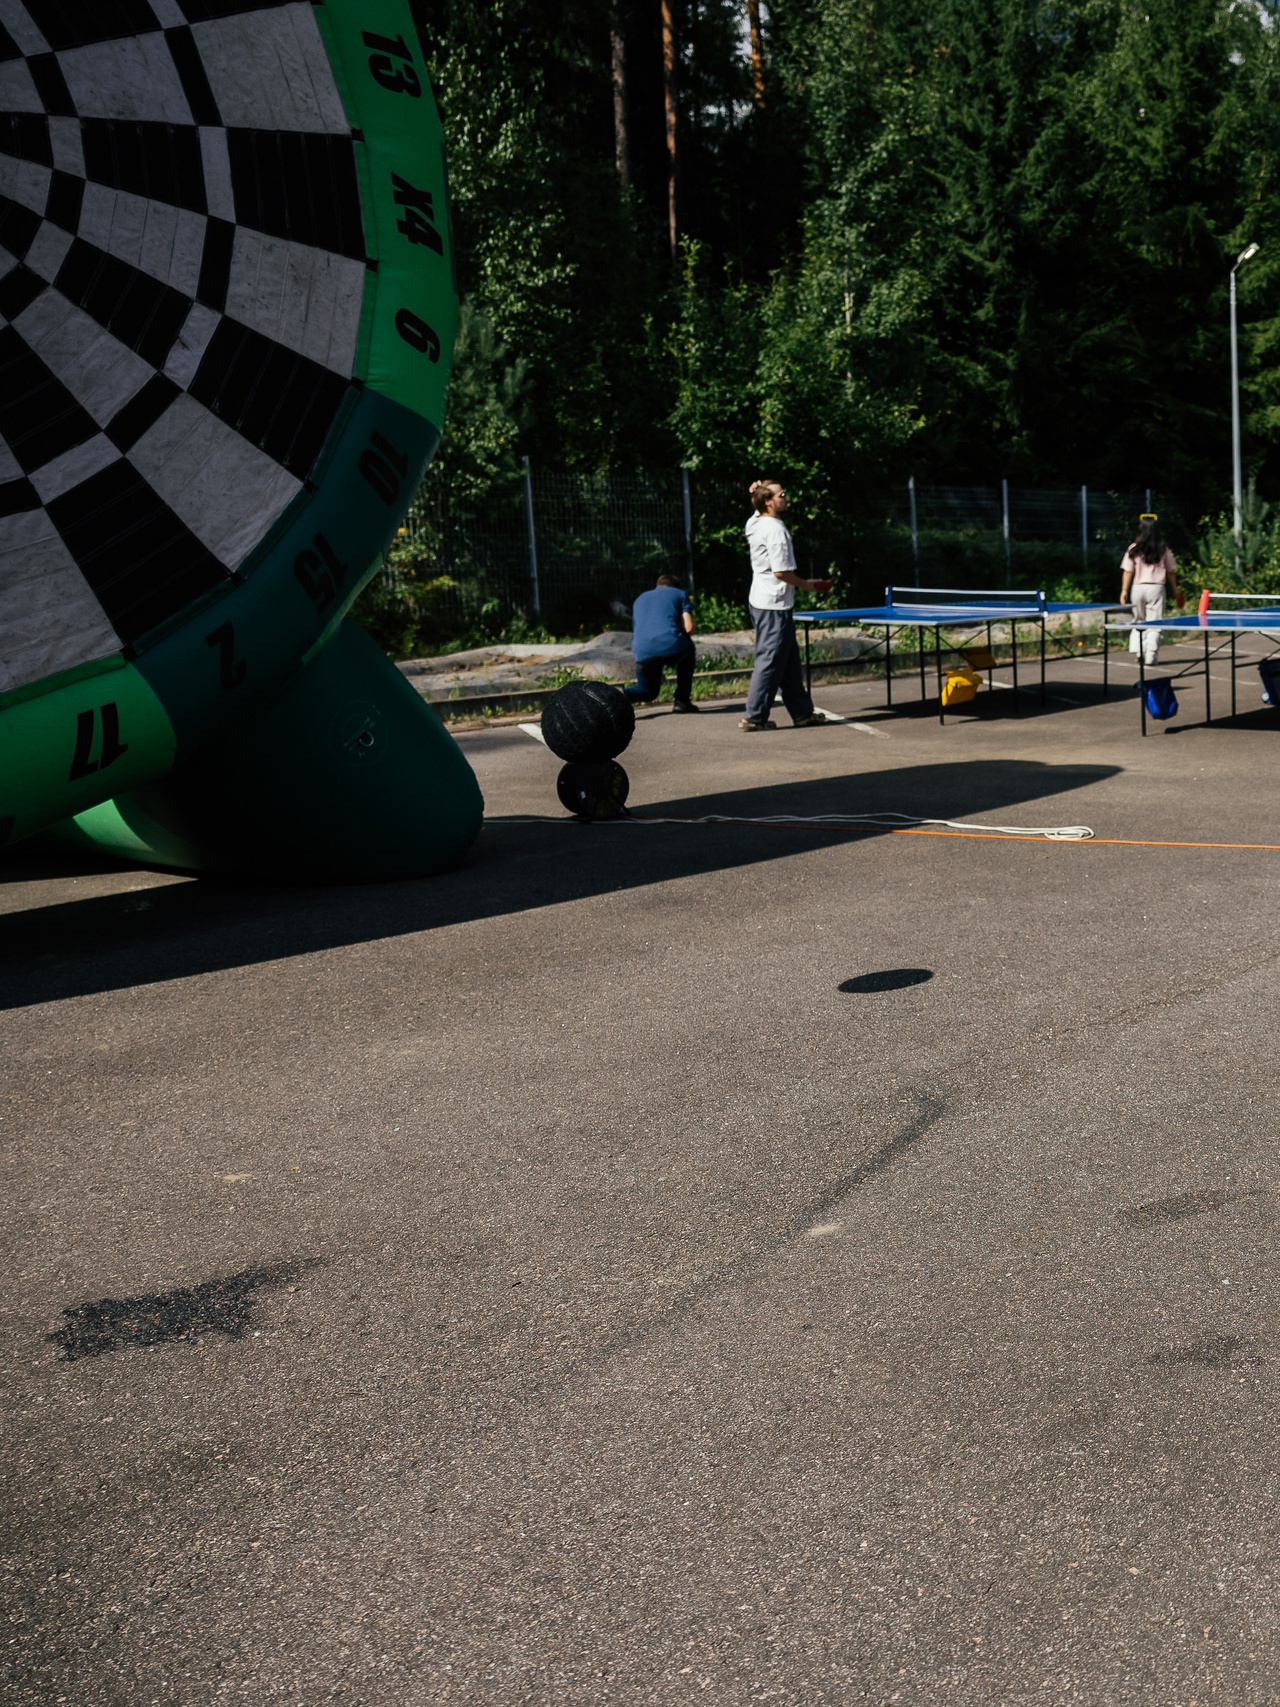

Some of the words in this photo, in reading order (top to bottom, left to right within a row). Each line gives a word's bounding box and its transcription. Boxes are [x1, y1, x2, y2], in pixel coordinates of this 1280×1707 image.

[361, 29, 422, 100] 13
[394, 307, 441, 365] 6
[358, 429, 410, 507] 10
[293, 532, 349, 614] 15
[205, 620, 248, 692] 2
[68, 701, 129, 782] 17
